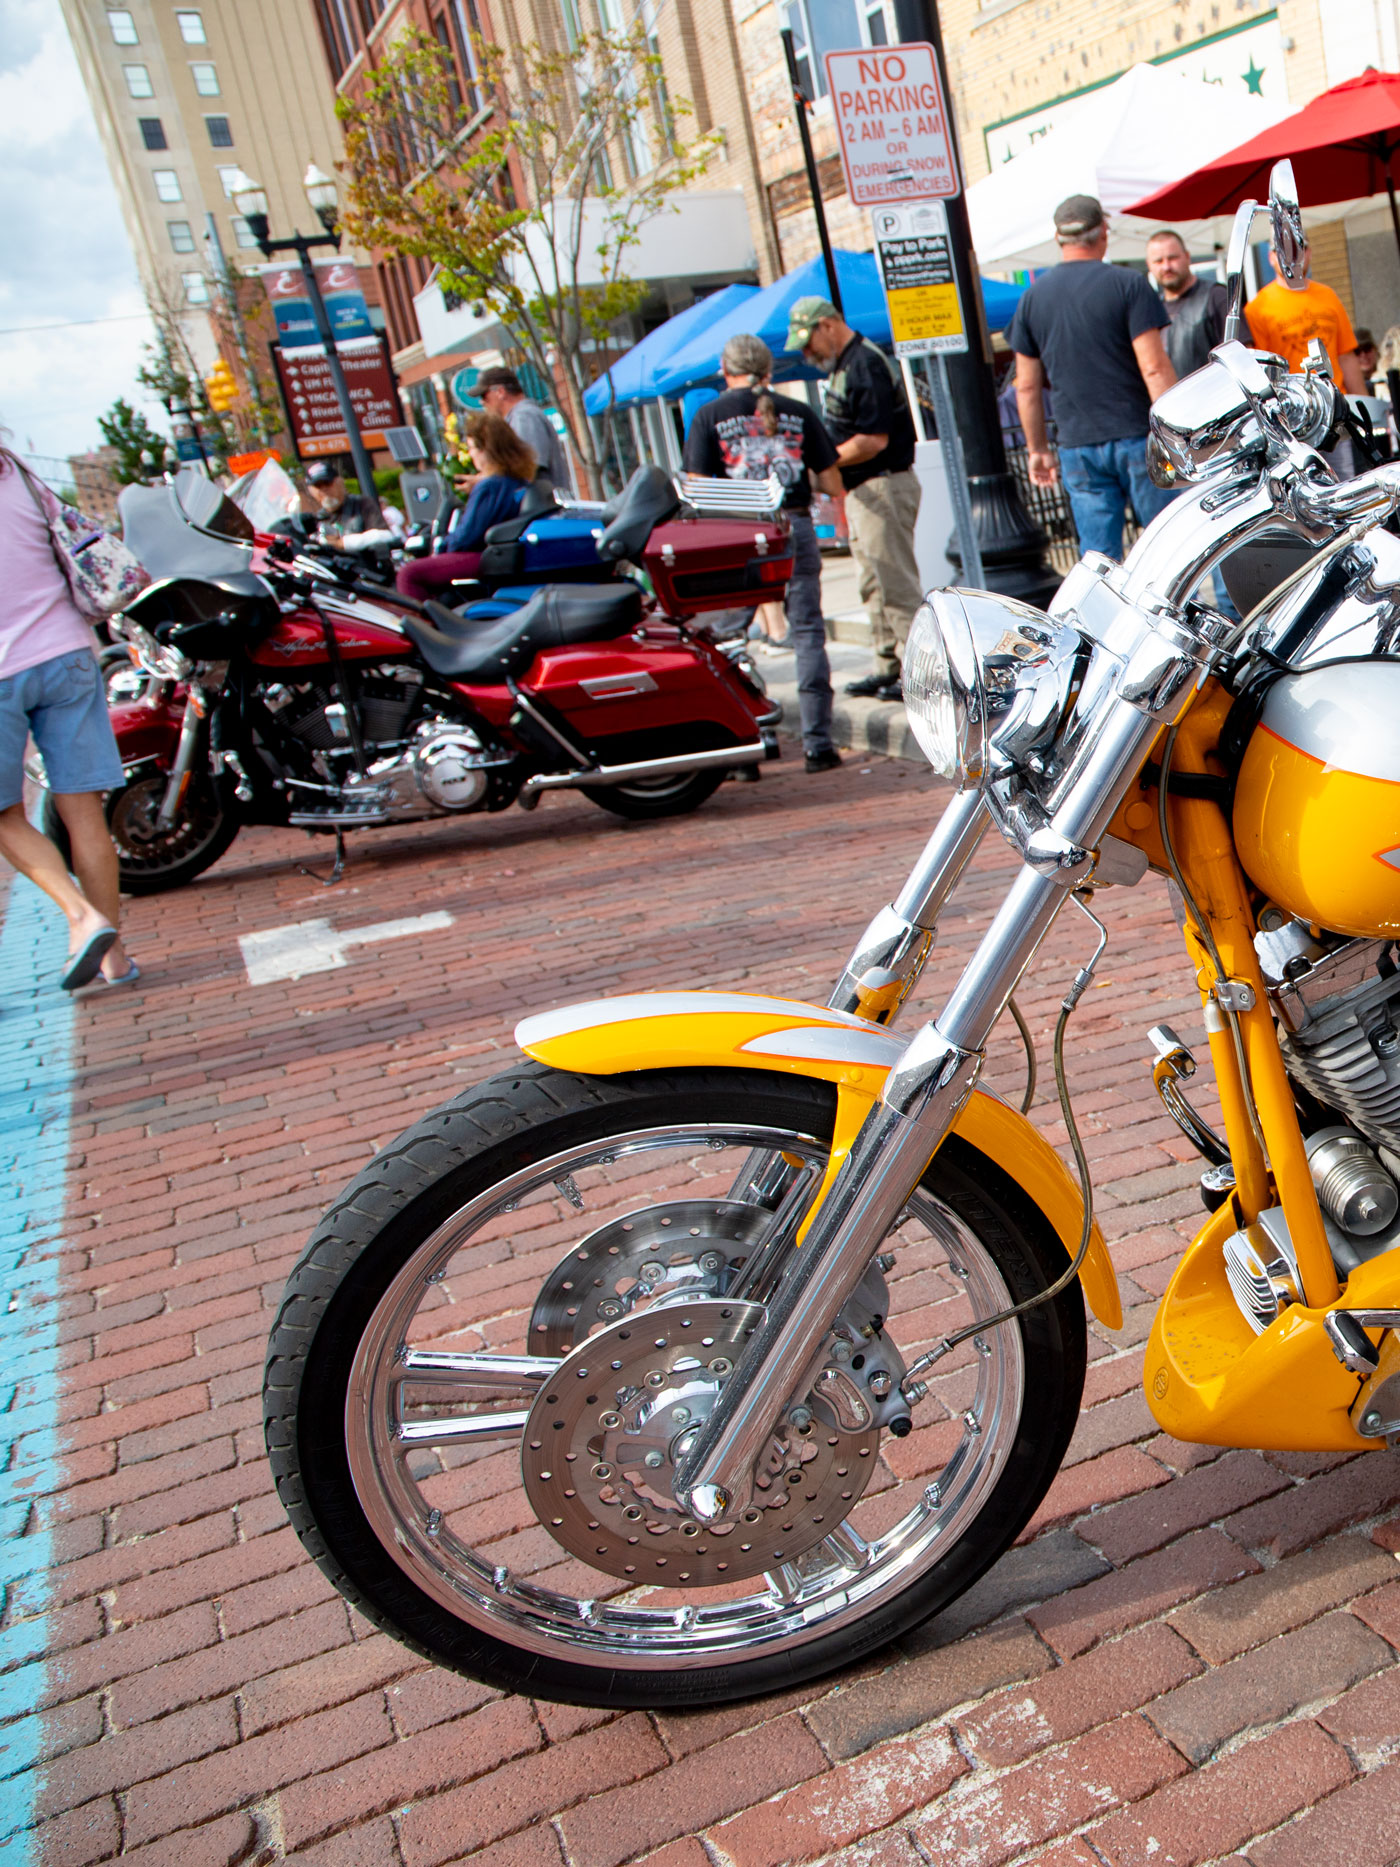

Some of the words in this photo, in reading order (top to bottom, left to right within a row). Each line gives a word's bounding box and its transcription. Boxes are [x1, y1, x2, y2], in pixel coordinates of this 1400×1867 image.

[857, 55, 906, 85] NO
[839, 83, 937, 117] PARKING
[846, 123, 856, 143] 2
[861, 119, 885, 142] AM
[902, 117, 912, 138] 6
[918, 114, 941, 136] AM
[886, 141, 908, 155] OR
[852, 160, 903, 179] DURING
[907, 155, 946, 172] SNOW
[857, 175, 951, 199] EMERGENCIES
[883, 216, 895, 233] P
[881, 241, 904, 256] Pay
[904, 240, 918, 253] to
[918, 236, 946, 251] Park
[899, 341, 928, 352] ZONE
[340, 358, 381, 371] Theater
[304, 378, 321, 390] UM
[367, 399, 392, 411] Park
[362, 413, 393, 427] Clinic
